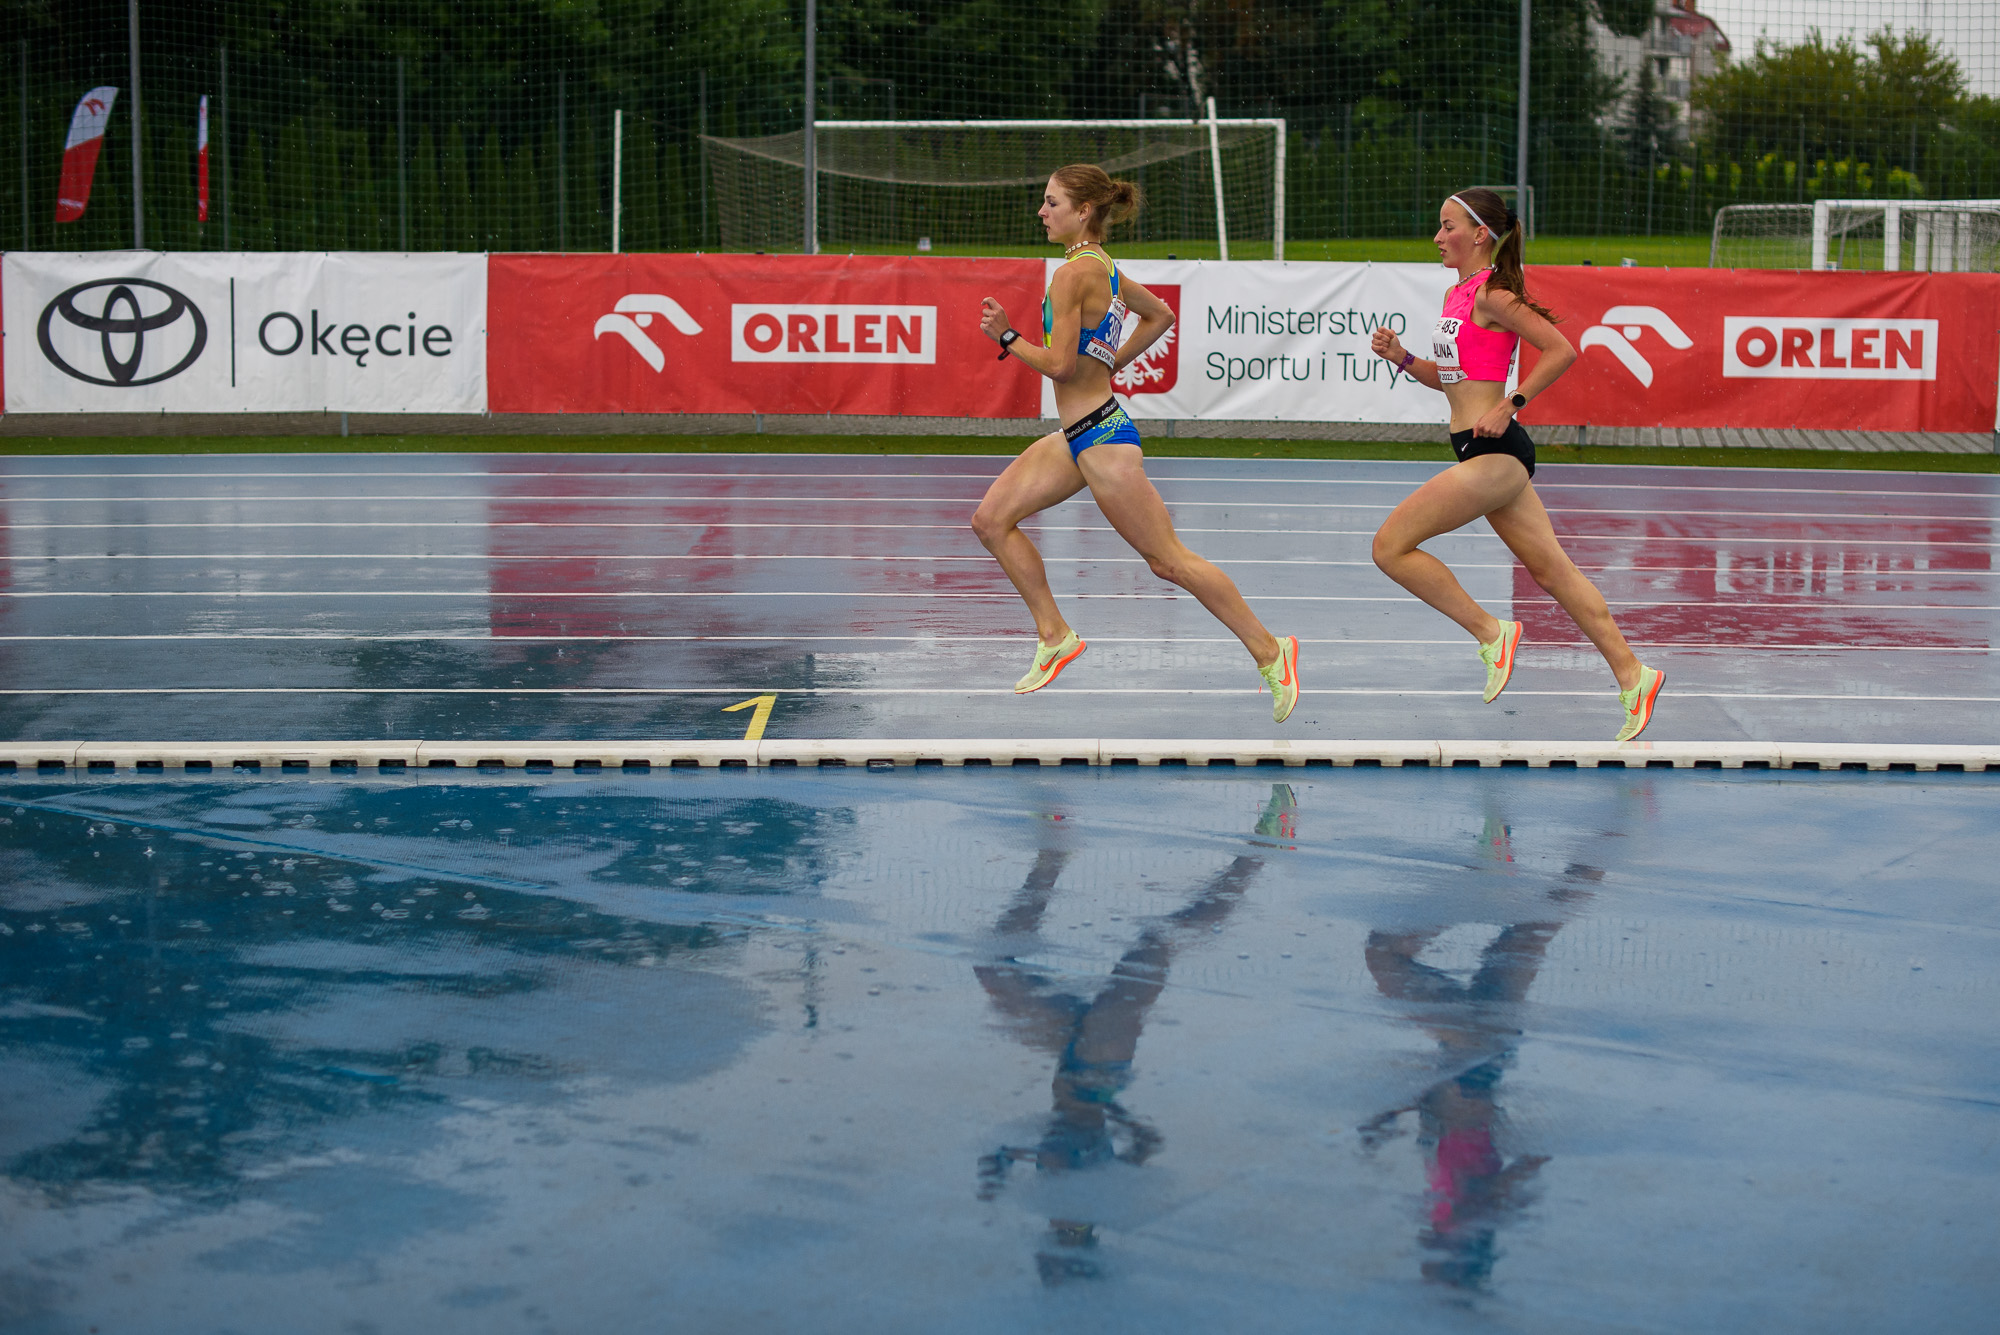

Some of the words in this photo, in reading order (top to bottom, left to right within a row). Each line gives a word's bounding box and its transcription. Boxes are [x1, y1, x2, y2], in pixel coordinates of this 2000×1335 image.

[258, 309, 453, 367] Okęcie
[743, 312, 922, 354] ORLEN
[1207, 304, 1406, 336] Ministerstwo
[1206, 351, 1310, 387] Sportu
[1321, 351, 1326, 381] i
[1735, 326, 1924, 370] ORLEN
[721, 695, 777, 740] 1
